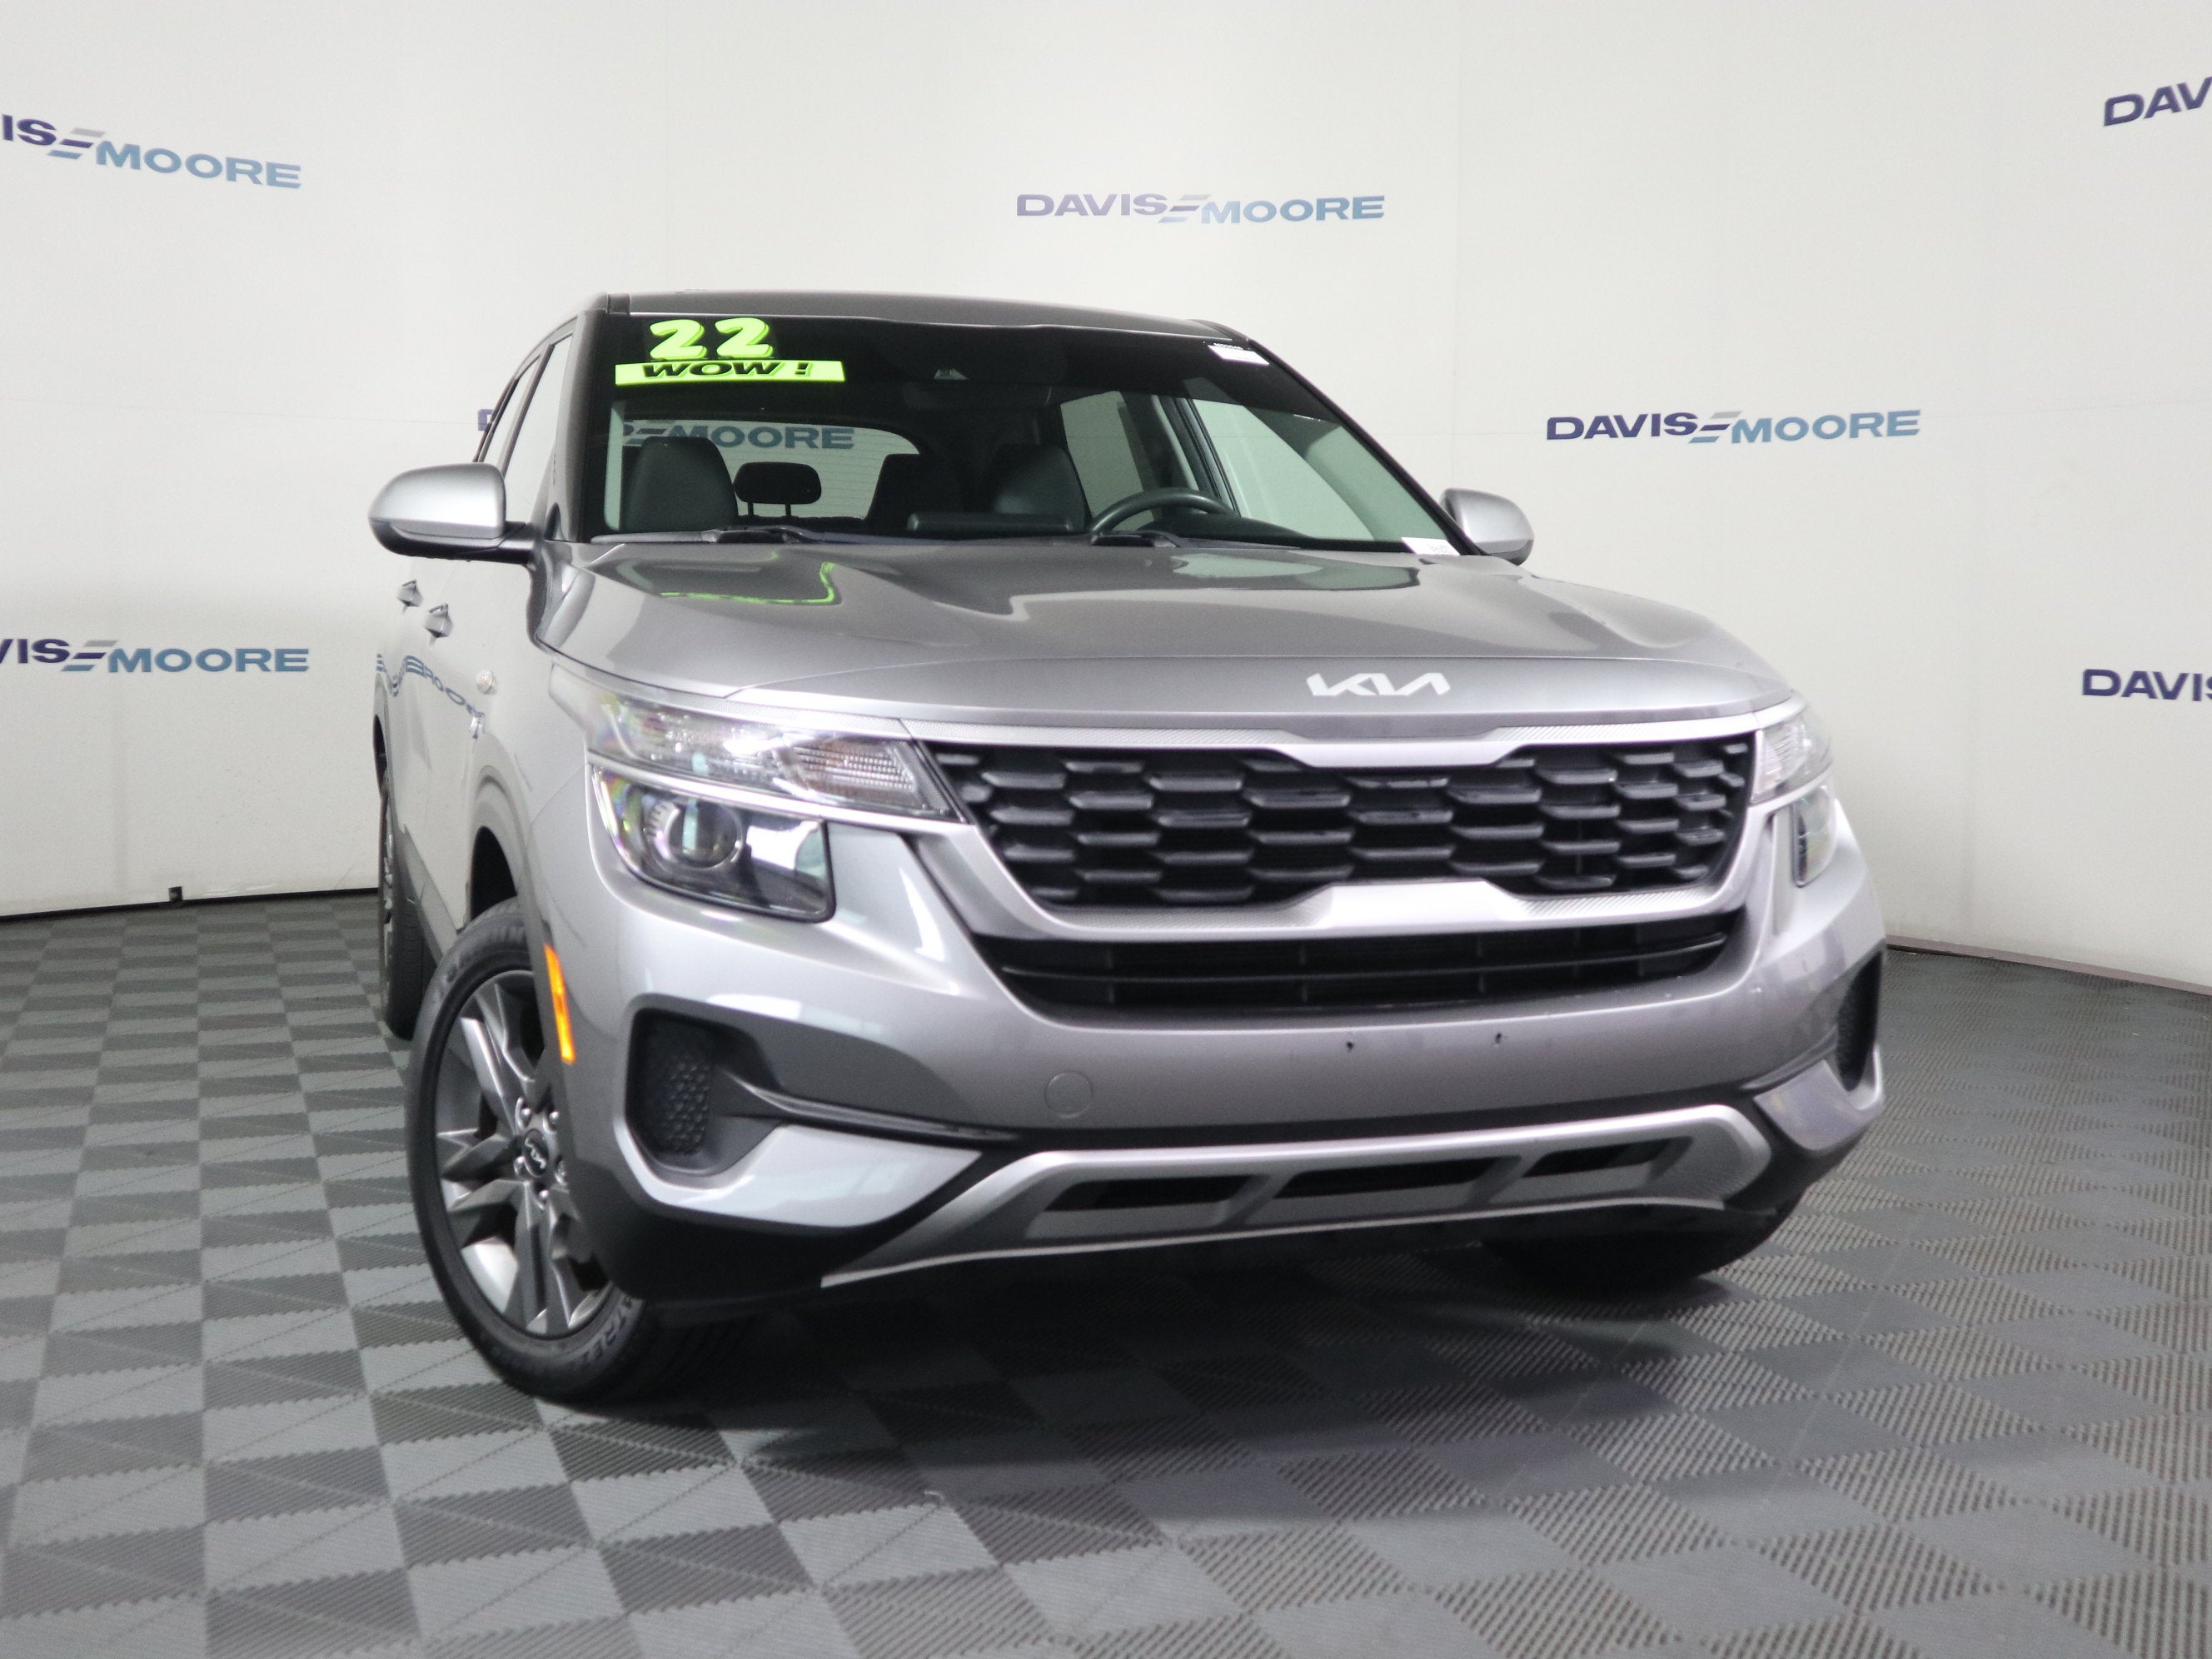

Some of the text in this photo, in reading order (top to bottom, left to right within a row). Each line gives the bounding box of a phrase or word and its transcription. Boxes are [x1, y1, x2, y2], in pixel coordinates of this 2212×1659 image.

[2104, 76, 2212, 127] DAV
[2, 114, 301, 189] IS MOORE
[1016, 193, 1385, 223] DAVIS MOORE
[650, 317, 775, 360] 22
[1547, 410, 1921, 444] DAVIS MOORE
[107, 648, 310, 673] MOORE
[1306, 672, 1451, 696] KIA
[2082, 668, 2212, 701] DAVI
